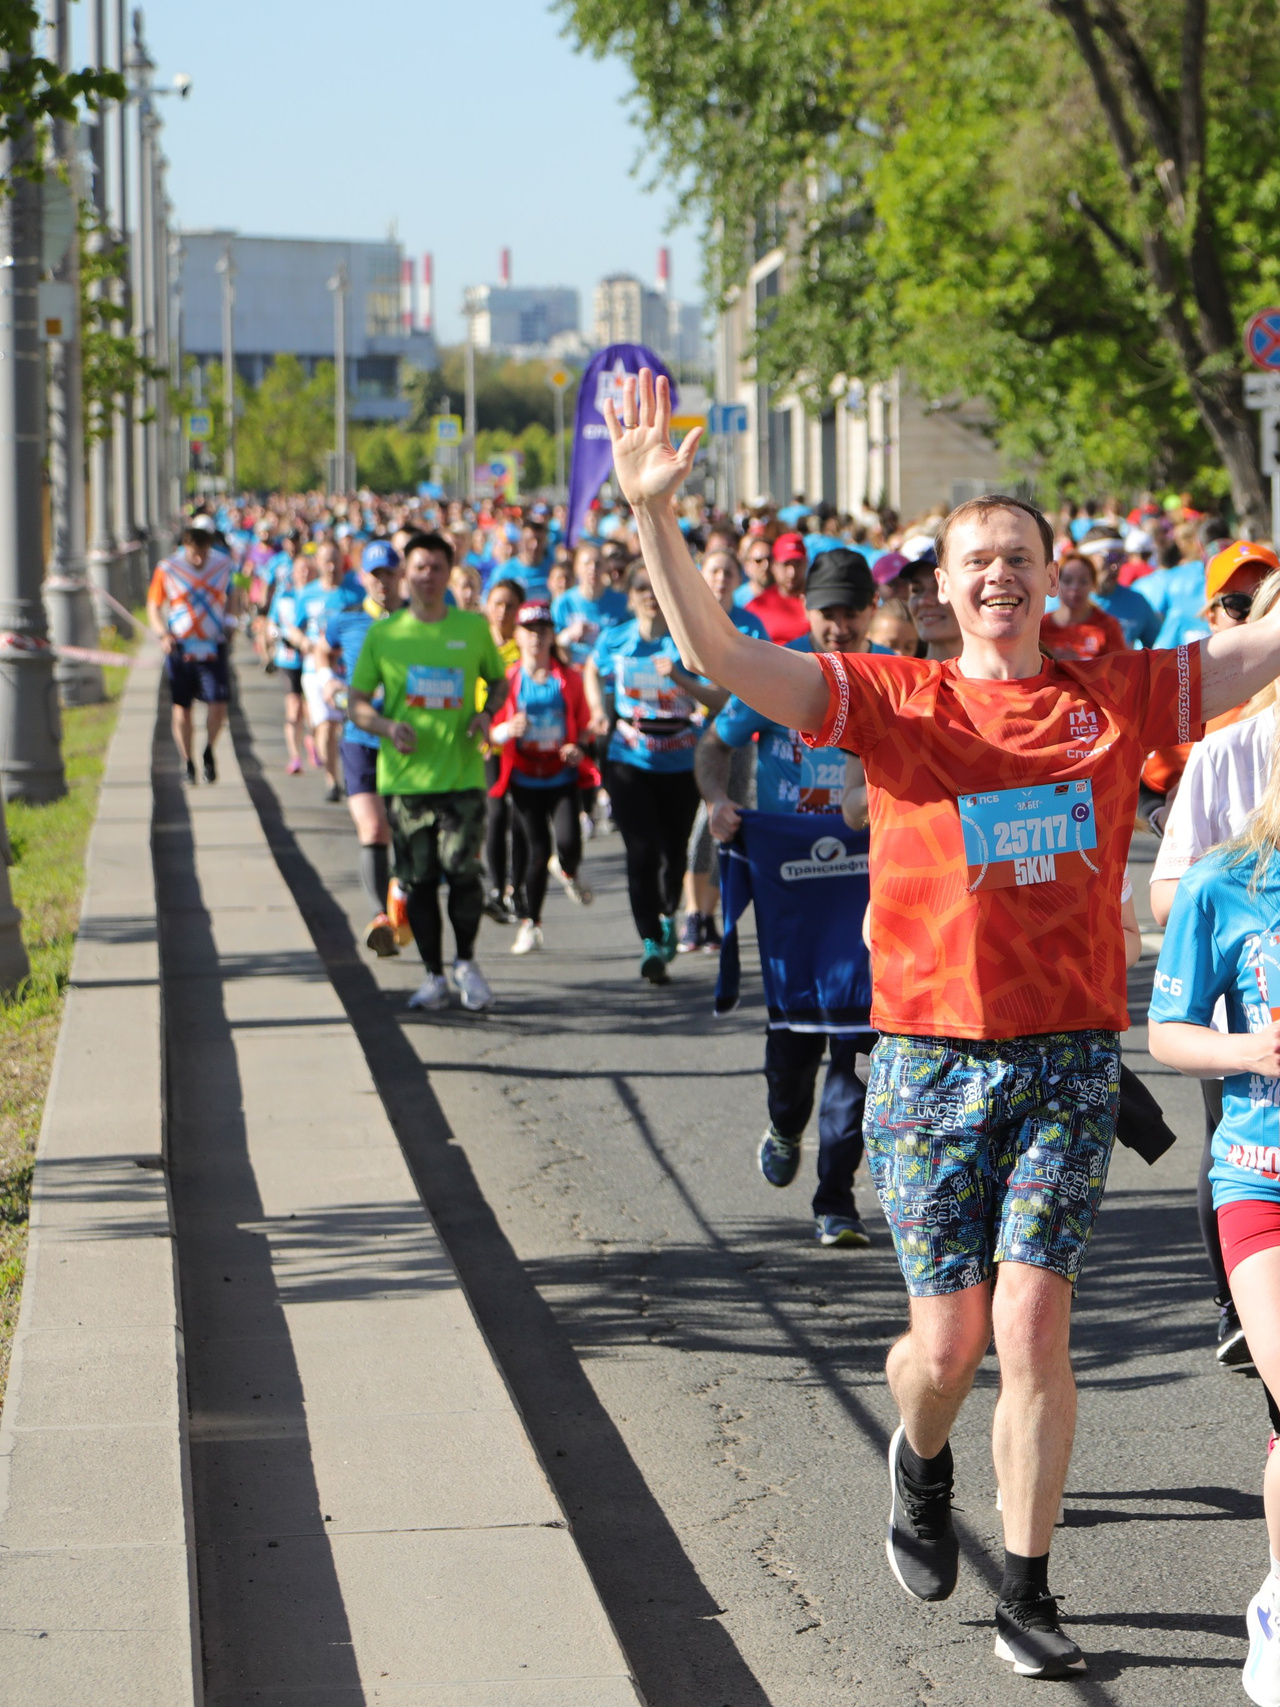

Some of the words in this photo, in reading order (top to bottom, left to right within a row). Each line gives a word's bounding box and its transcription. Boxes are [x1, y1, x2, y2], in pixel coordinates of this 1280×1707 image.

[1070, 725, 1099, 736] ПСБ
[1066, 743, 1112, 759] СПОРТ
[979, 795, 1000, 805] ПСБ
[993, 814, 1067, 856] 25717
[1067, 1078, 1109, 1097] UNDER
[1077, 1091, 1106, 1106] SEA
[917, 1102, 965, 1122] UNDER
[931, 1118, 963, 1131] SEA
[1047, 1166, 1089, 1190] UNDER
[1059, 1184, 1087, 1201] SEA
[913, 1195, 960, 1216] UNDER
[926, 1210, 960, 1226] SEA
